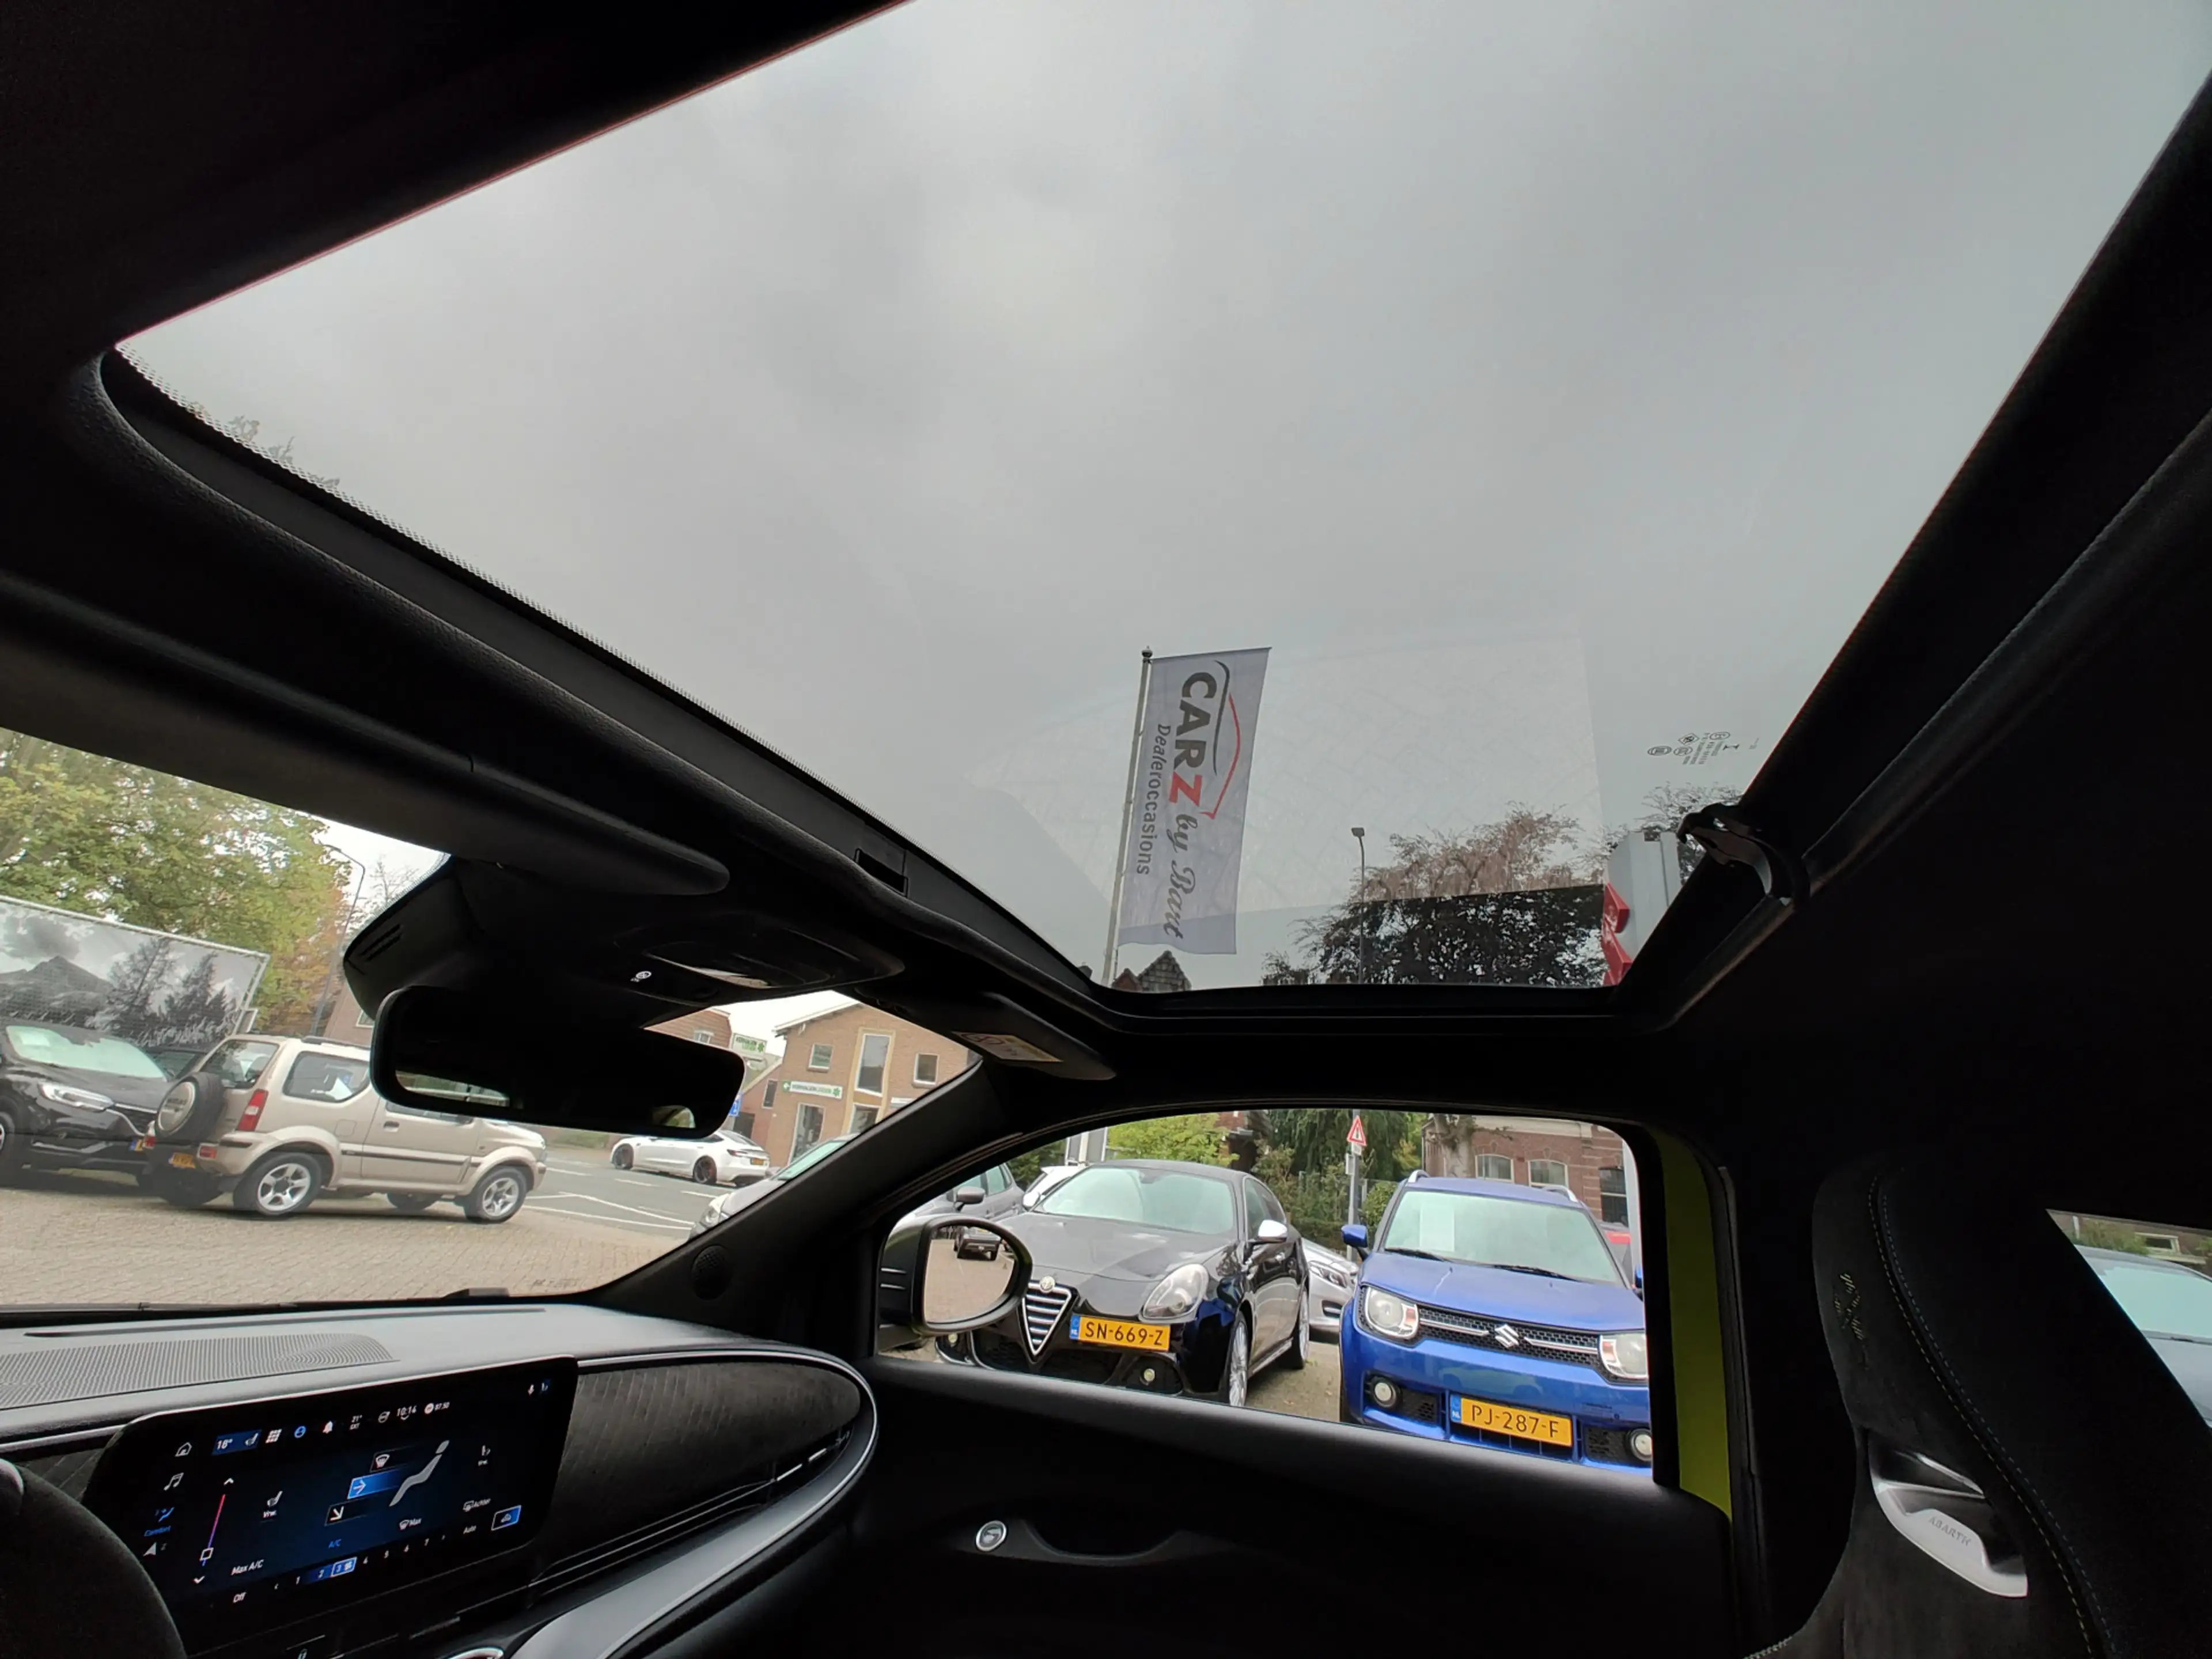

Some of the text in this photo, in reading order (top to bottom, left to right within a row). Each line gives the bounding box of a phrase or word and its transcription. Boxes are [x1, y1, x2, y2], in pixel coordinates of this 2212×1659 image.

[1137, 724, 1171, 875] Dealeroccasions
[1164, 672, 1217, 939] CARZ by Bart
[1085, 1321, 1164, 1346] SN-669-Z
[1471, 1404, 1559, 1438] PJ-287-F
[1928, 1516, 1971, 1546] ABARTH
[231, 1559, 264, 1575] Max A/C
[233, 1592, 247, 1603] Off
